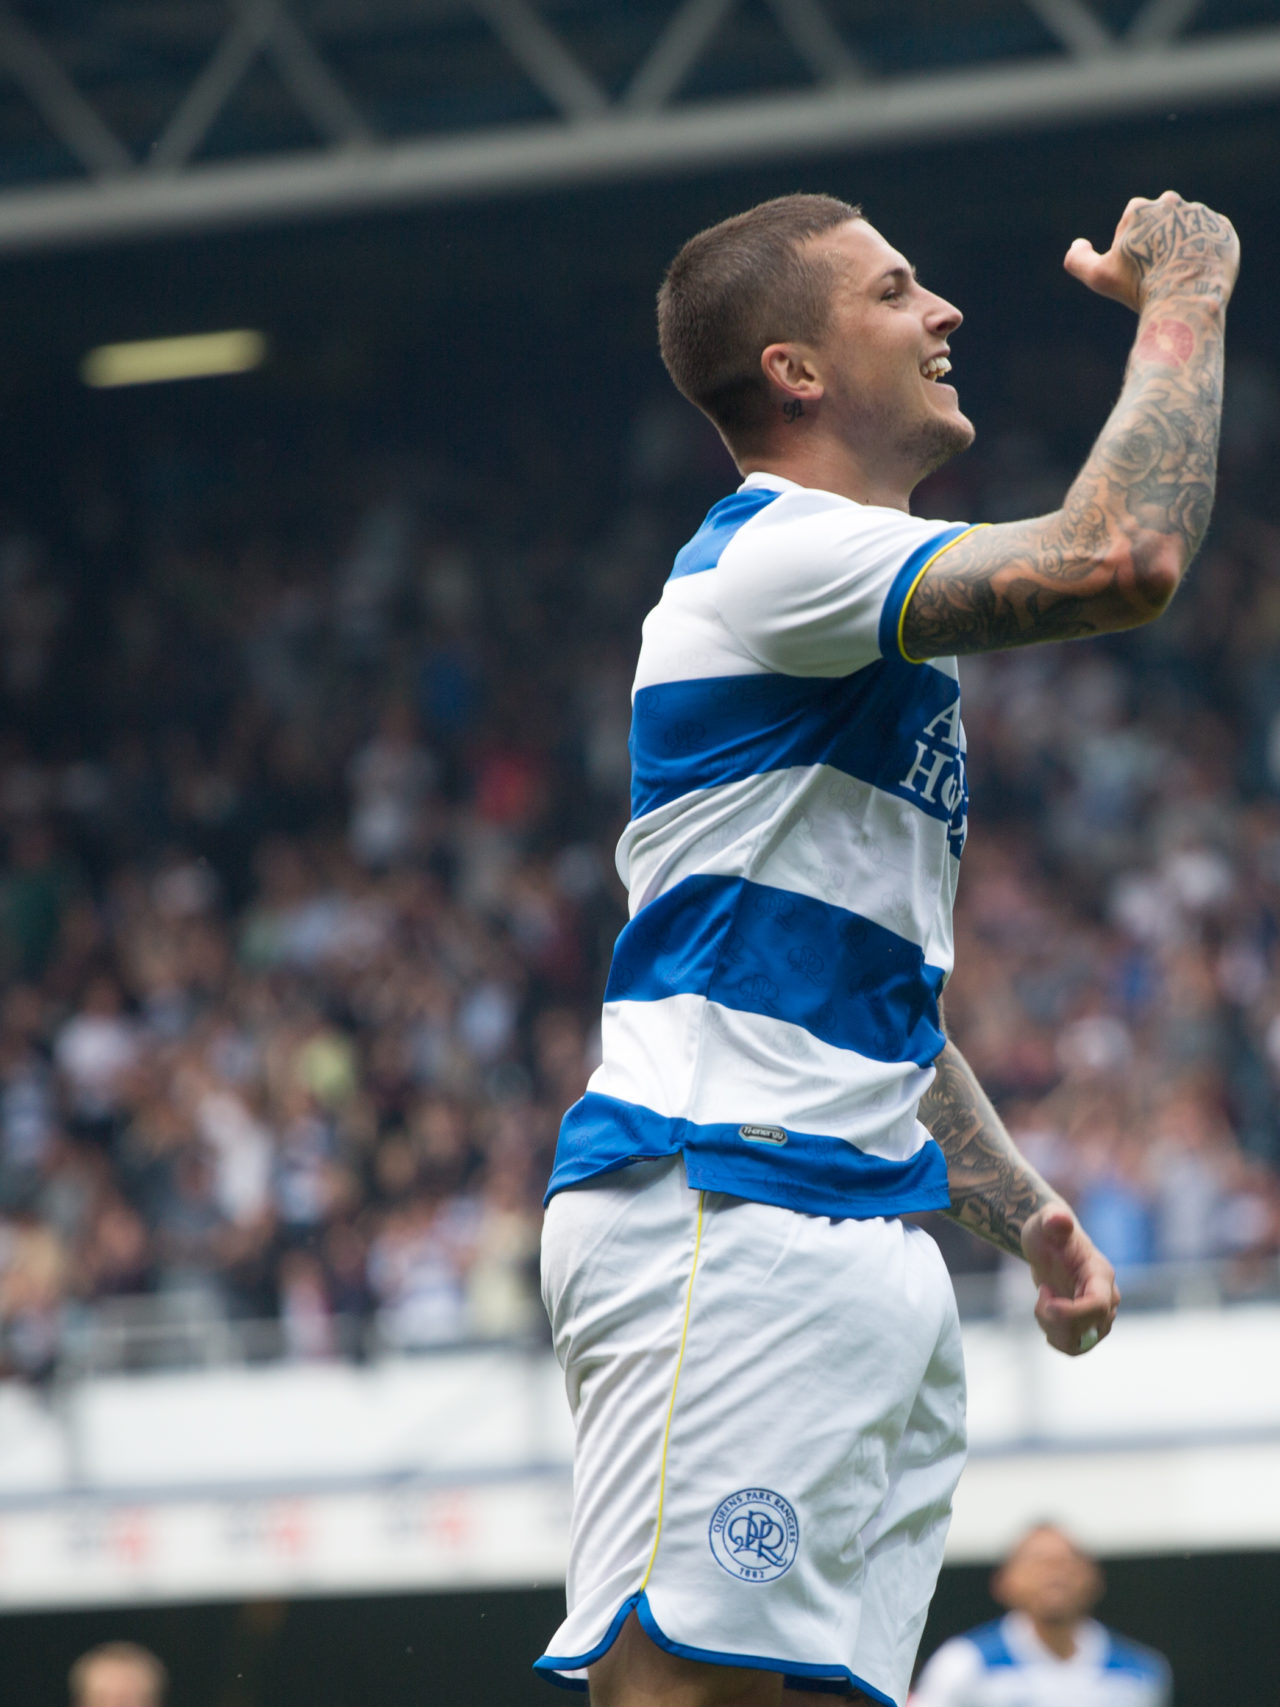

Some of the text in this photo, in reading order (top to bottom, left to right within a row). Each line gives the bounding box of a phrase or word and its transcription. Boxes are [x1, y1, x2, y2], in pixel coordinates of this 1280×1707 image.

[713, 1492, 797, 1544] QUEENS PARK RANGERS
